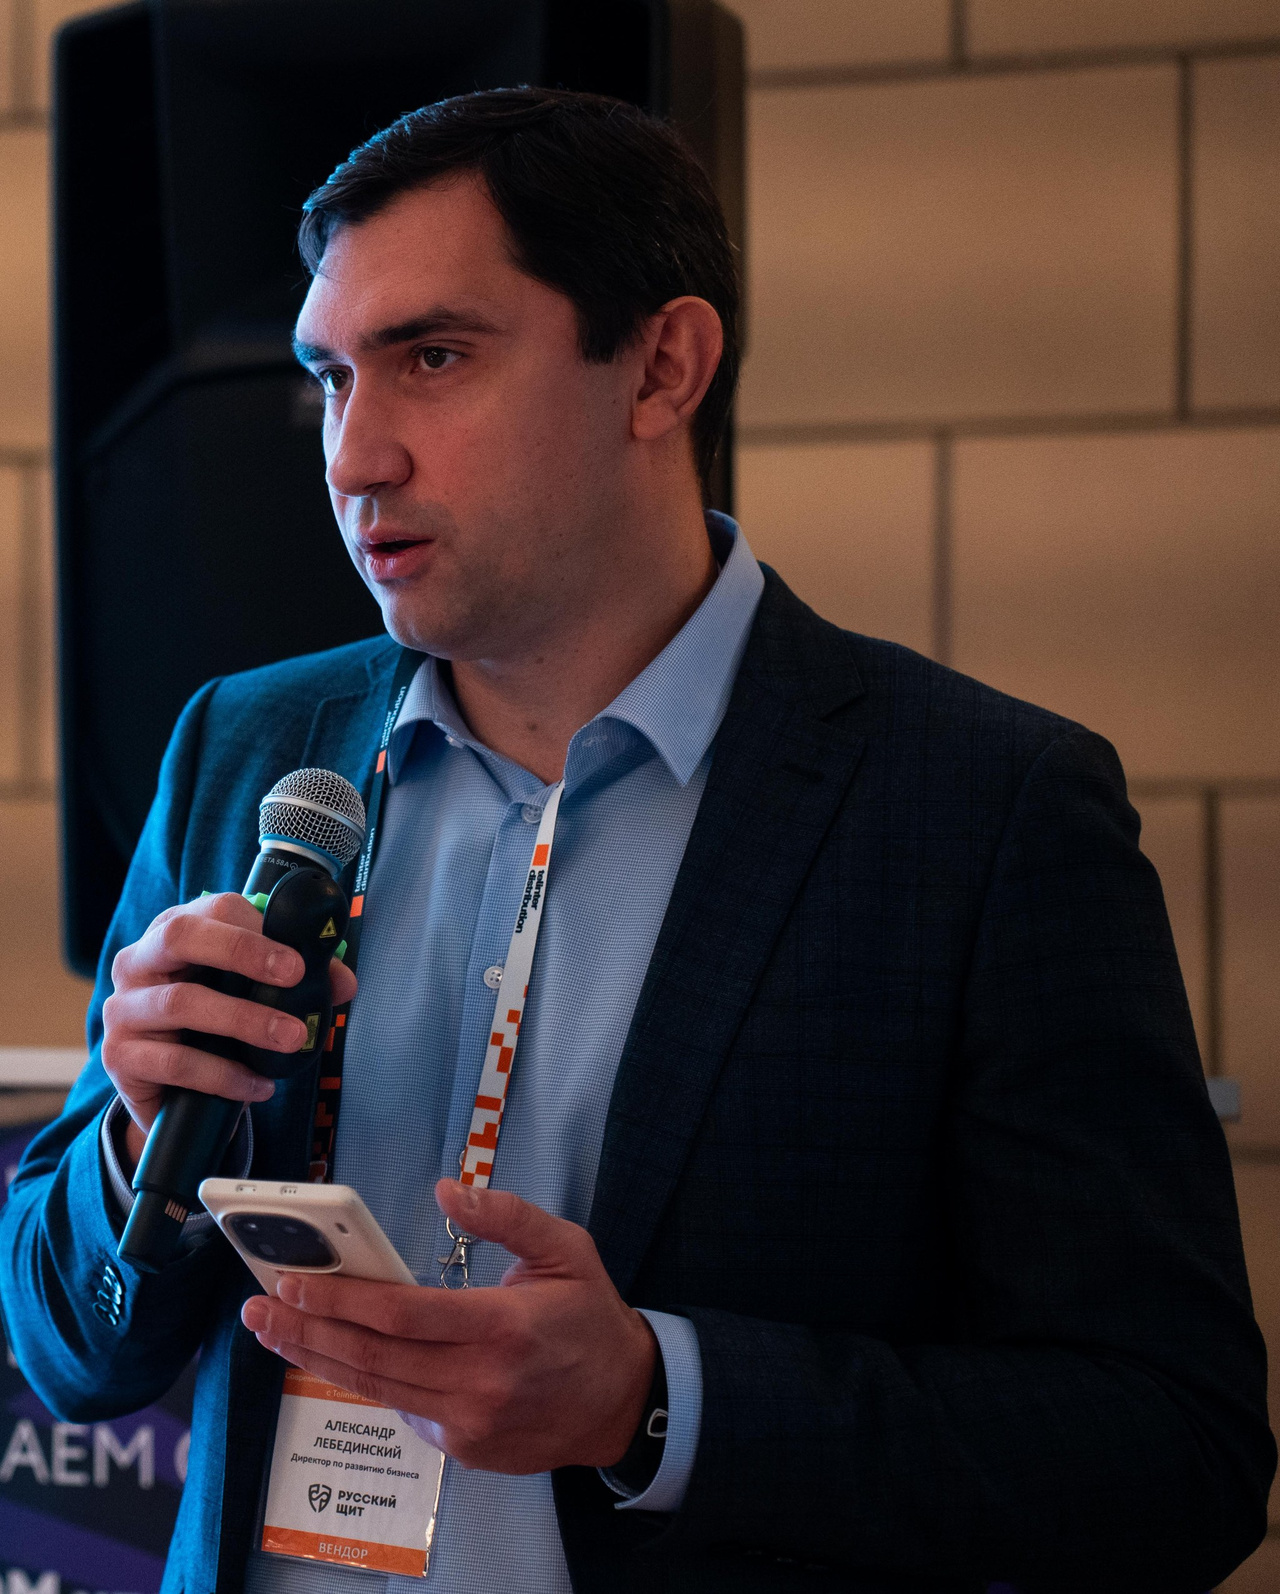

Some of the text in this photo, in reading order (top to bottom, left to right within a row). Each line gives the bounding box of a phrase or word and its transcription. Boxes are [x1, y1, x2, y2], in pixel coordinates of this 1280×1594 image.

[361, 827, 376, 892] distribution
[515, 869, 537, 934] distribution
[531, 869, 545, 911] telinter
[324, 1419, 396, 1441] АЛЕКСАНДР
[313, 1436, 402, 1460] ЛЕБЕДИНСКИЙ
[290, 1452, 331, 1468] Директор
[344, 1461, 385, 1475] развитию
[386, 1466, 420, 1480] бизнеса
[335, 1503, 365, 1517] ЩИТ
[337, 1490, 397, 1509] РУССКИЙ
[318, 1542, 369, 1560] ВЕНДОР
